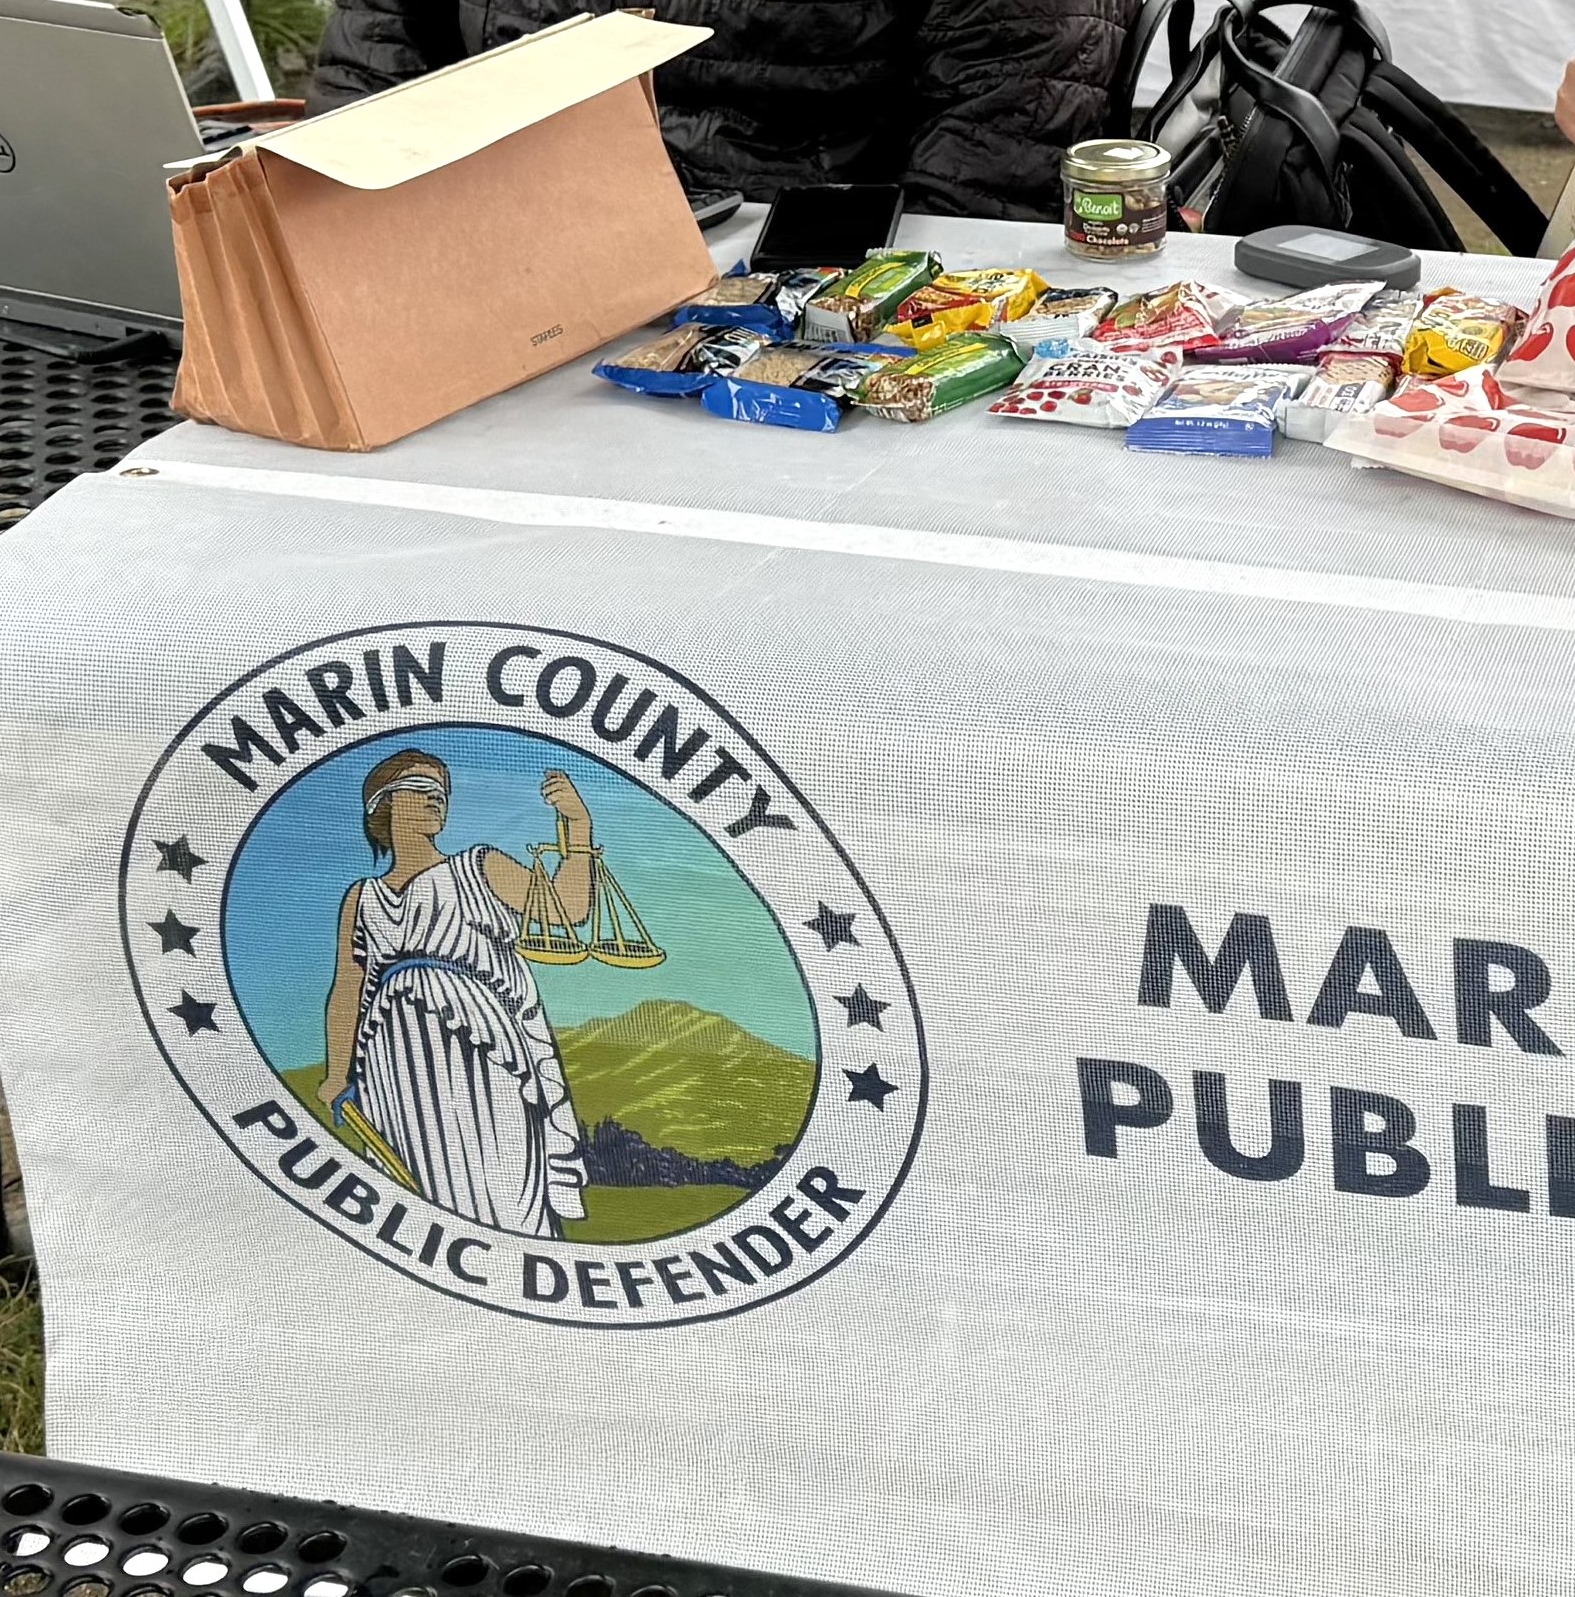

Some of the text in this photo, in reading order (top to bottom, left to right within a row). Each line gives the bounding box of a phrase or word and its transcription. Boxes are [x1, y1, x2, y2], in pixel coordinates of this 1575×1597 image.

[529, 323, 564, 346] STAPLES
[199, 640, 799, 840] MARIN COUNTY
[231, 1098, 867, 1310] PUBLIC DEFENDER
